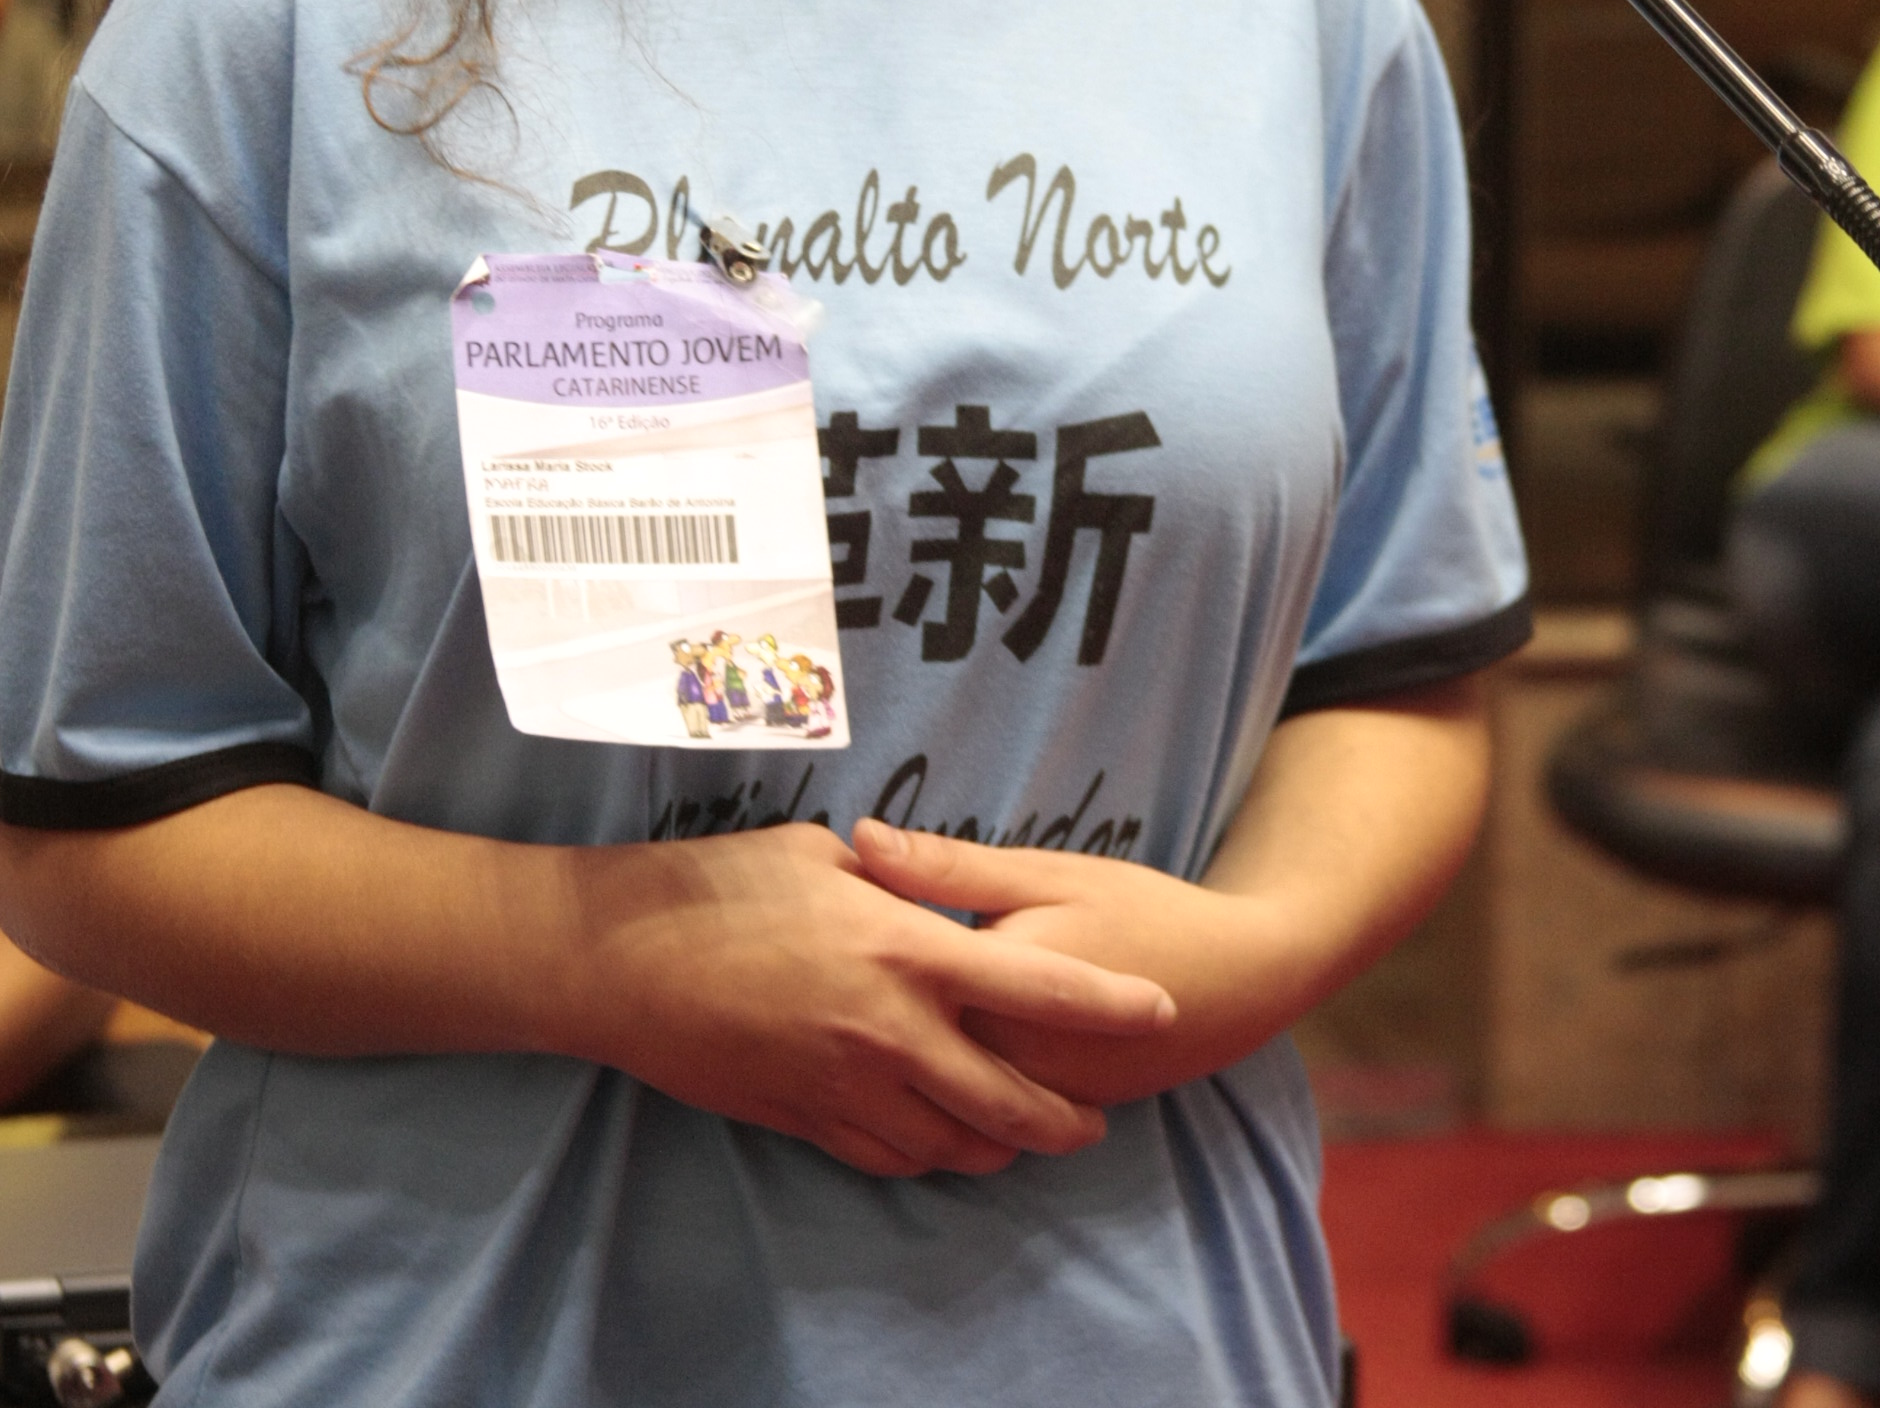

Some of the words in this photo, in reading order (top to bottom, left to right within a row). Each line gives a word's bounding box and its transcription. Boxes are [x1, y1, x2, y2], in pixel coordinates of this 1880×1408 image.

[569, 168, 967, 287] Plnalto
[986, 153, 1232, 289] Norte
[575, 311, 664, 331] Programa
[466, 339, 669, 368] PARLAMENTO
[682, 333, 783, 364] JOVEM
[553, 375, 700, 397] CATARINENSE
[617, 414, 671, 432] Edição
[535, 460, 571, 473] Maria
